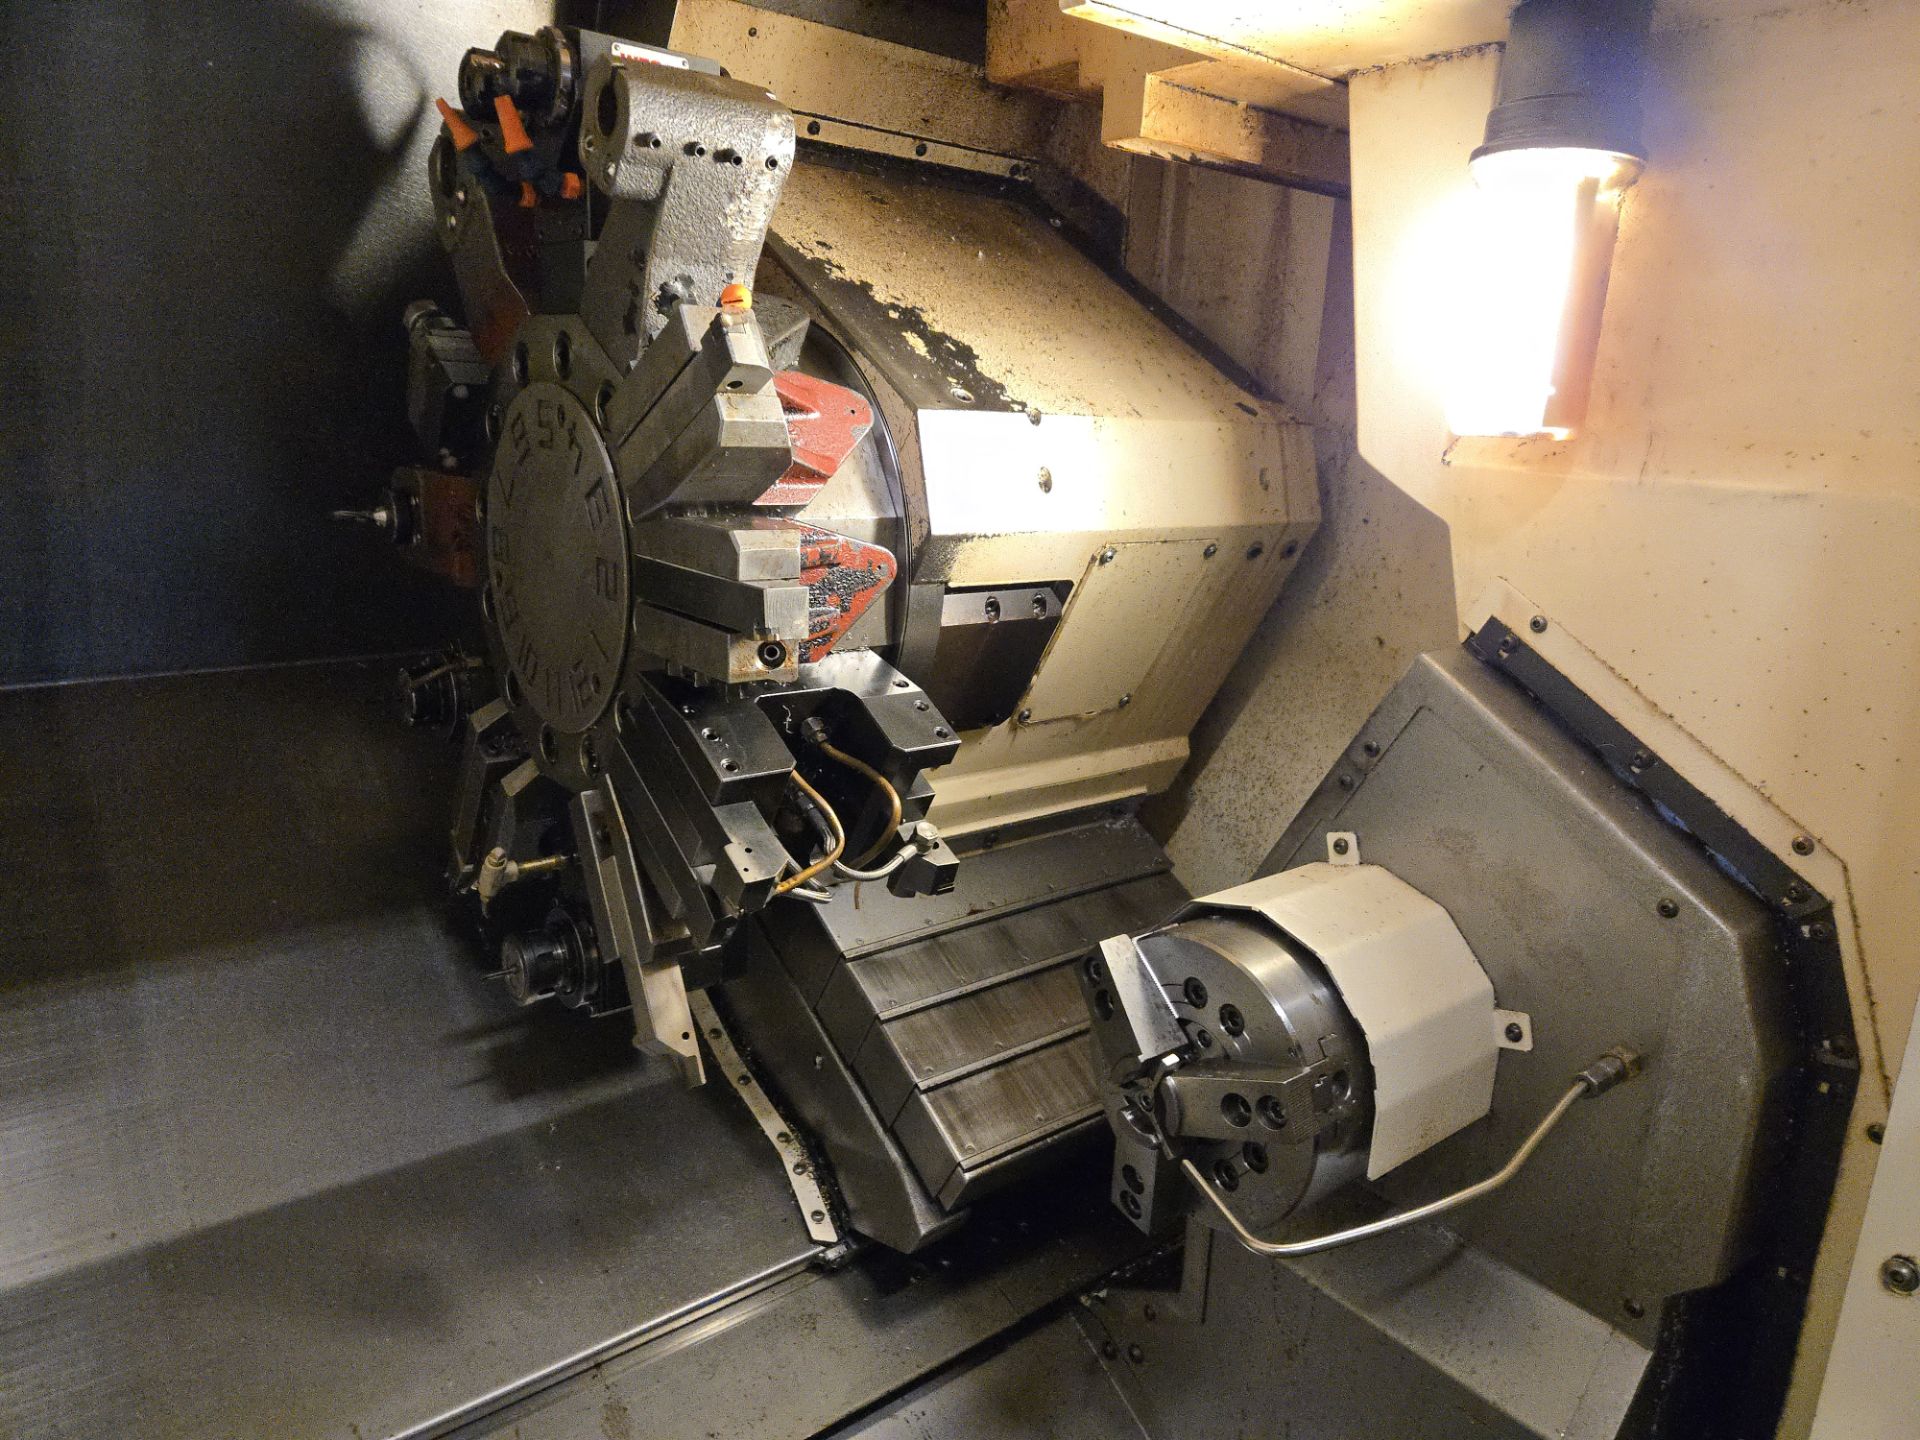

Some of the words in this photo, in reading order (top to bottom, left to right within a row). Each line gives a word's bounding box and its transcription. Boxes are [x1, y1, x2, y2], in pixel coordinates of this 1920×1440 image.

[537, 400, 554, 450] 5
[568, 421, 583, 475] 4
[585, 476, 611, 532] 3
[596, 556, 618, 602] 2
